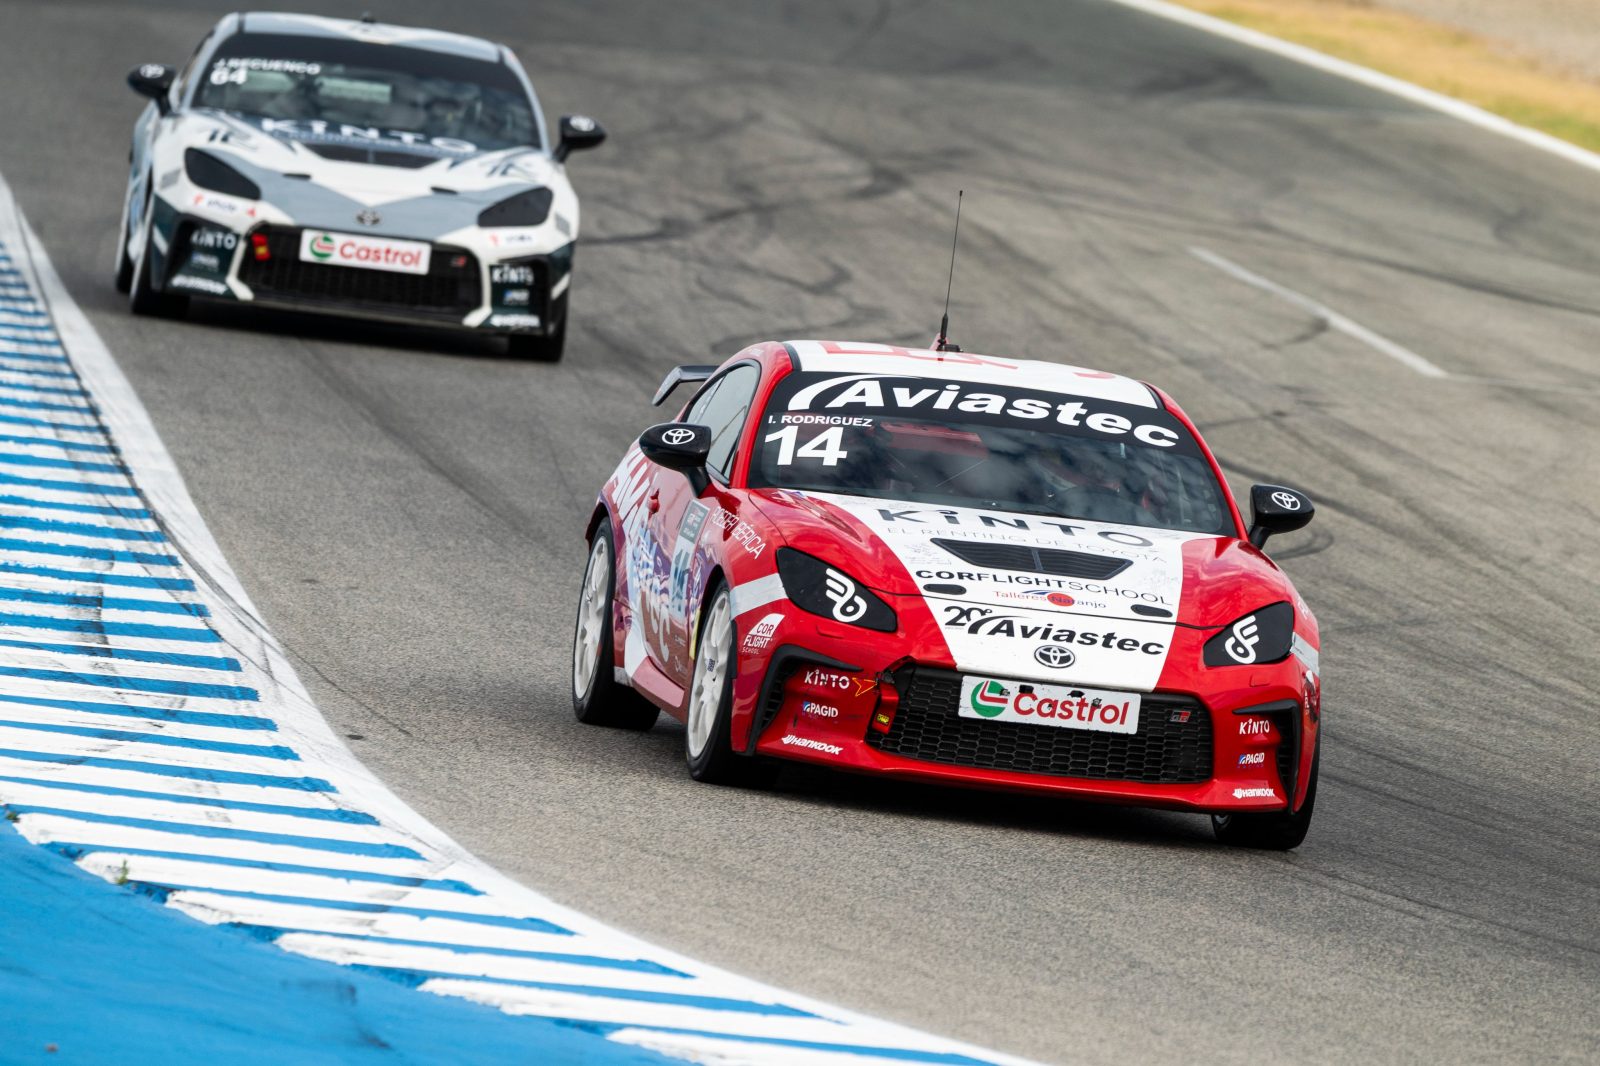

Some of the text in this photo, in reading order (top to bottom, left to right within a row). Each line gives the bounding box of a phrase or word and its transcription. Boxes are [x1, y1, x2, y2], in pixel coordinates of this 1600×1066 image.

[210, 68, 248, 85] 64
[340, 241, 422, 267] Castrol
[768, 415, 873, 427] I. RODRIGUEZ
[825, 380, 1180, 448] Aviastec
[765, 425, 848, 467] 14
[921, 529, 1027, 544] RENTING
[1072, 543, 1167, 564] TOYOTA
[916, 570, 1175, 606] CORFLIGHTSCHOOL
[993, 591, 1107, 609] Talleres Naranjo
[757, 622, 775, 636] COR
[987, 618, 1165, 655] Aviastec
[743, 634, 771, 649] FLIGHT
[810, 703, 839, 718] PAGID
[1013, 692, 1130, 725] Castrol
[1246, 752, 1265, 764] PAGID
